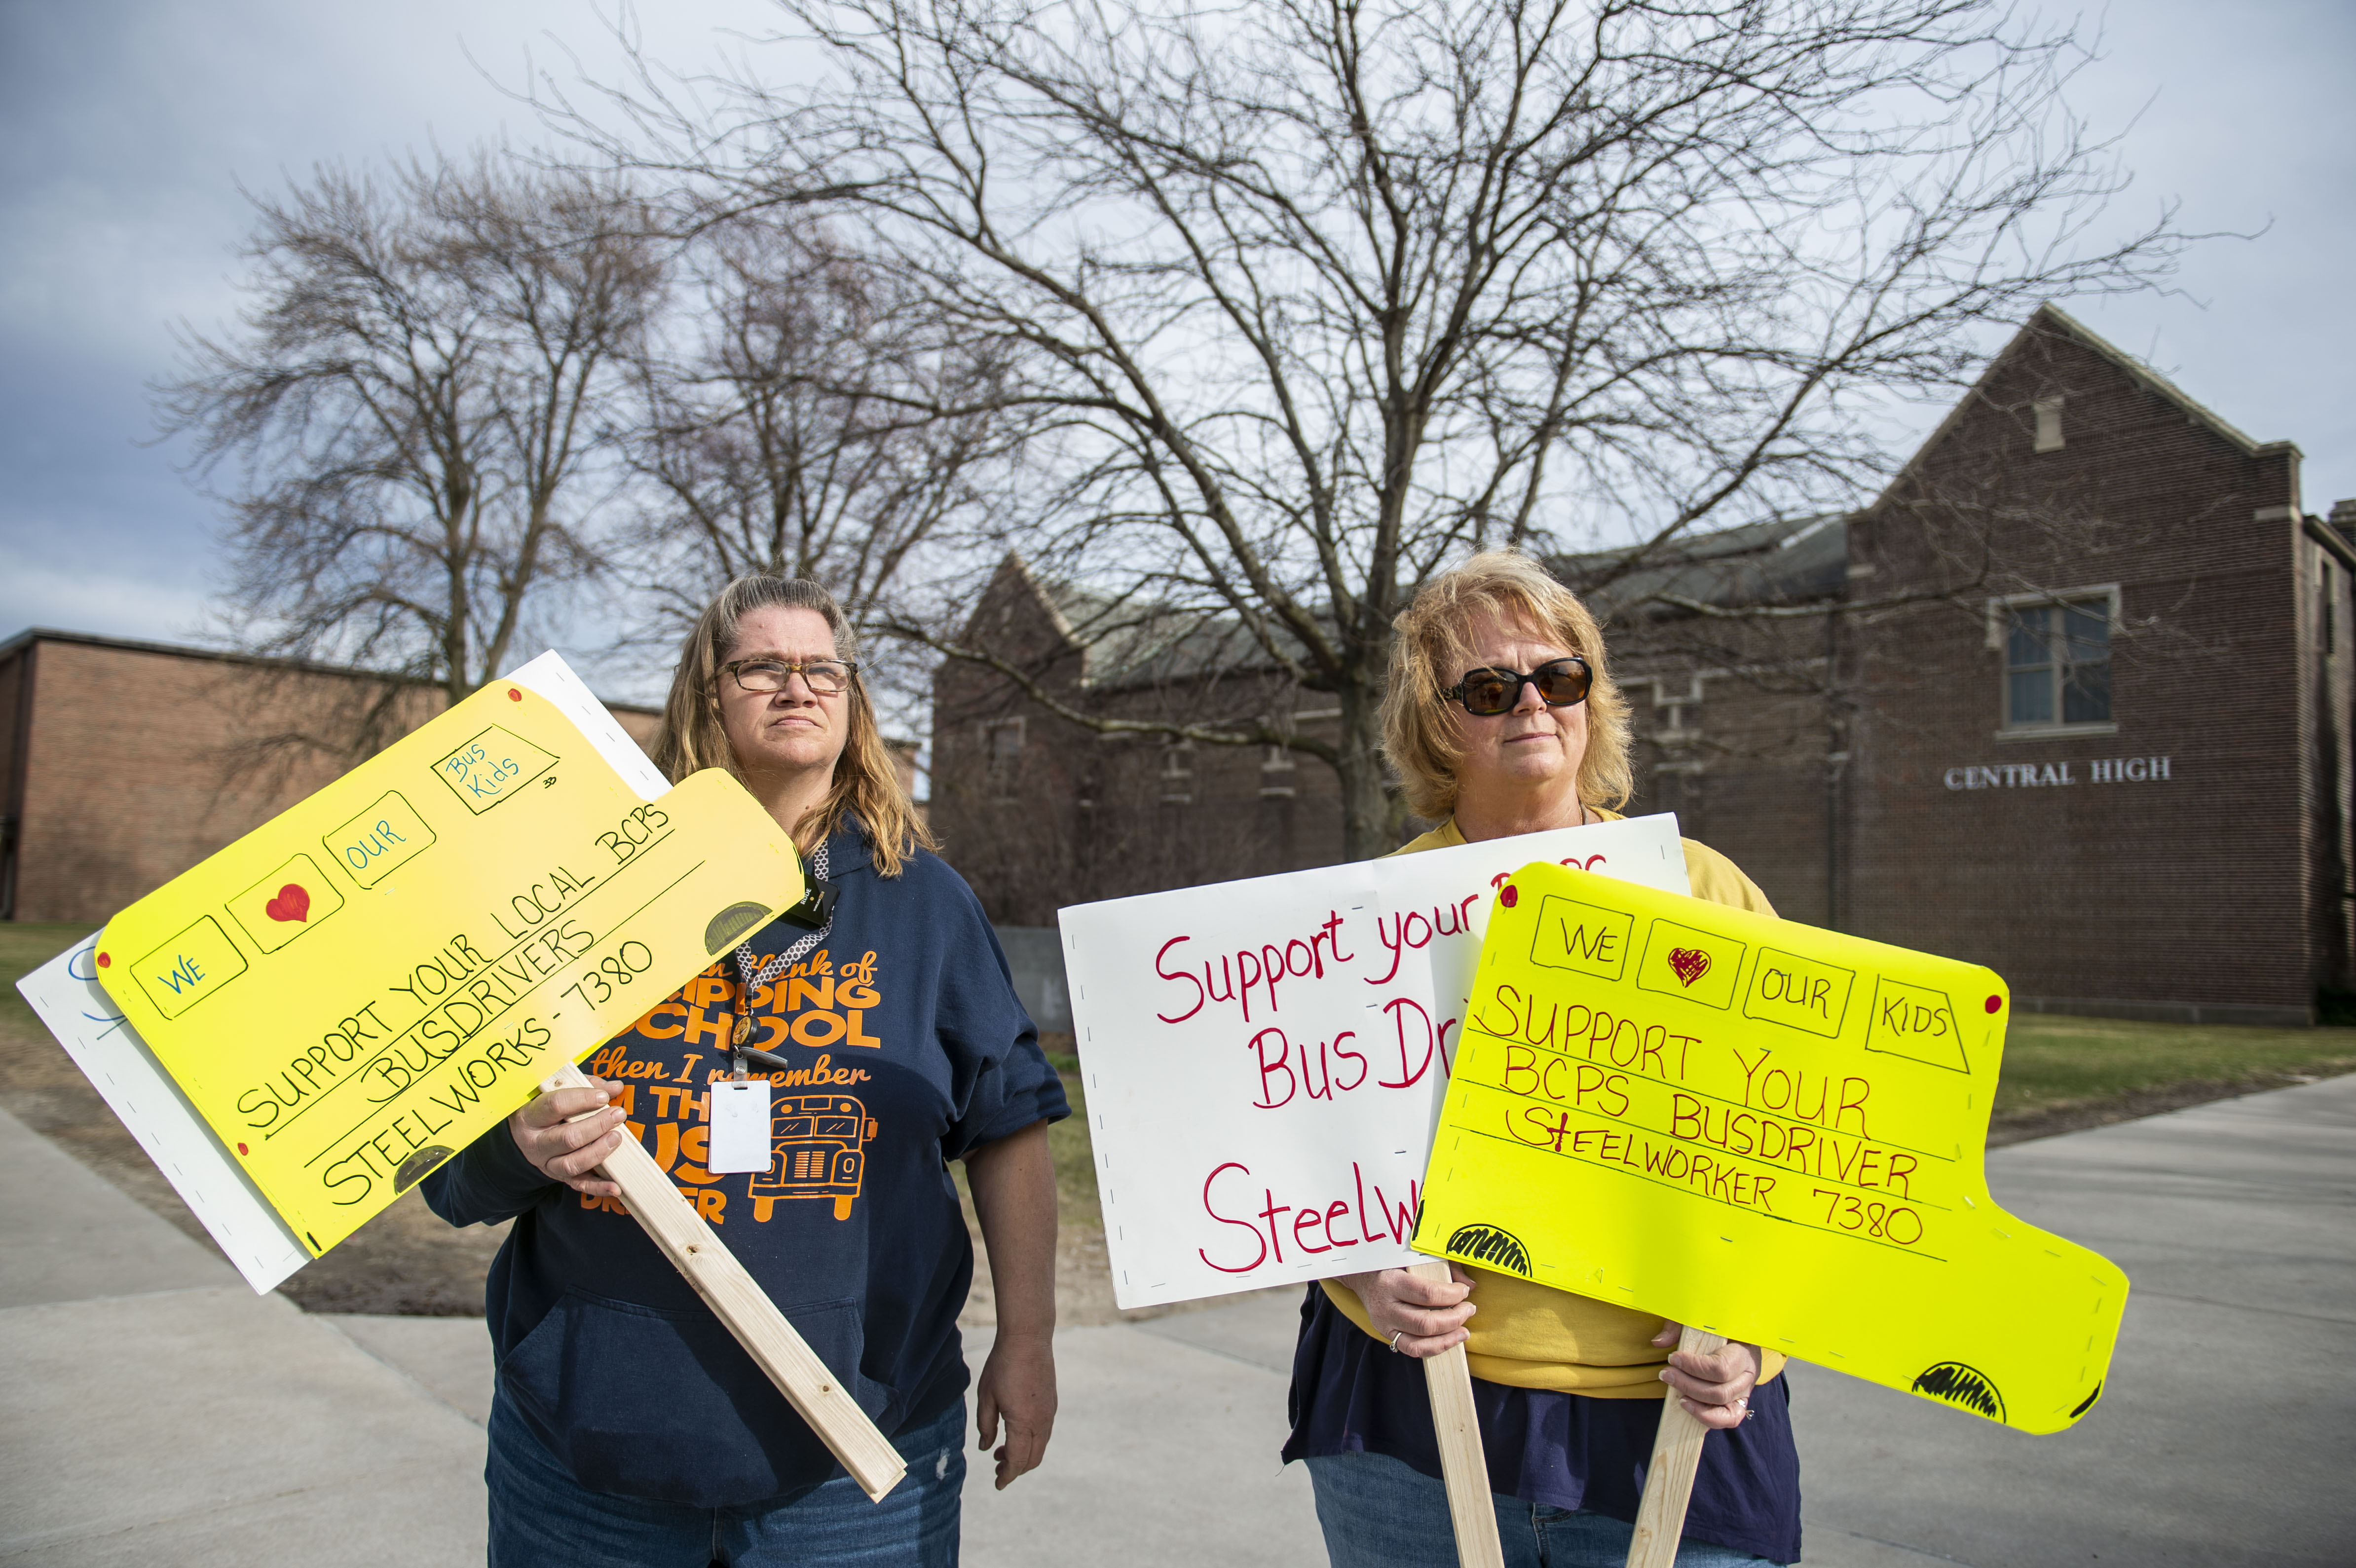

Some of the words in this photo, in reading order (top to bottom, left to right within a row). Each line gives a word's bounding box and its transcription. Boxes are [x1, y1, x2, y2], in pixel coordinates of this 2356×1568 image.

[466, 758, 520, 798] Kids
[1943, 762, 2075, 790] CENTRAL
[2090, 756, 2170, 784] HIGH
[346, 820, 407, 869] OUR
[1156, 909, 1354, 1024] Support
[1363, 894, 1479, 985] your
[1561, 917, 1618, 962] WE
[157, 954, 206, 994] WE
[237, 1001, 393, 1128] SUPPORT
[389, 934, 493, 1006] YOUR
[490, 866, 596, 939] LOCAL
[595, 803, 669, 865] BCPS
[840, 951, 878, 985] of
[1761, 968, 1831, 1019] OUR
[1882, 996, 1949, 1037] KIDS
[613, 1003, 881, 1052] CHOOL
[590, 1045, 670, 1080] then
[672, 1053, 704, 1083] I
[1248, 1027, 1368, 1109] Bus
[1473, 985, 1702, 1080] SUPPORT
[1733, 1048, 1871, 1141] YOUR
[1499, 1045, 1629, 1117] BCPS
[649, 1085, 711, 1122] TH
[1813, 1189, 1923, 1245] 7380
